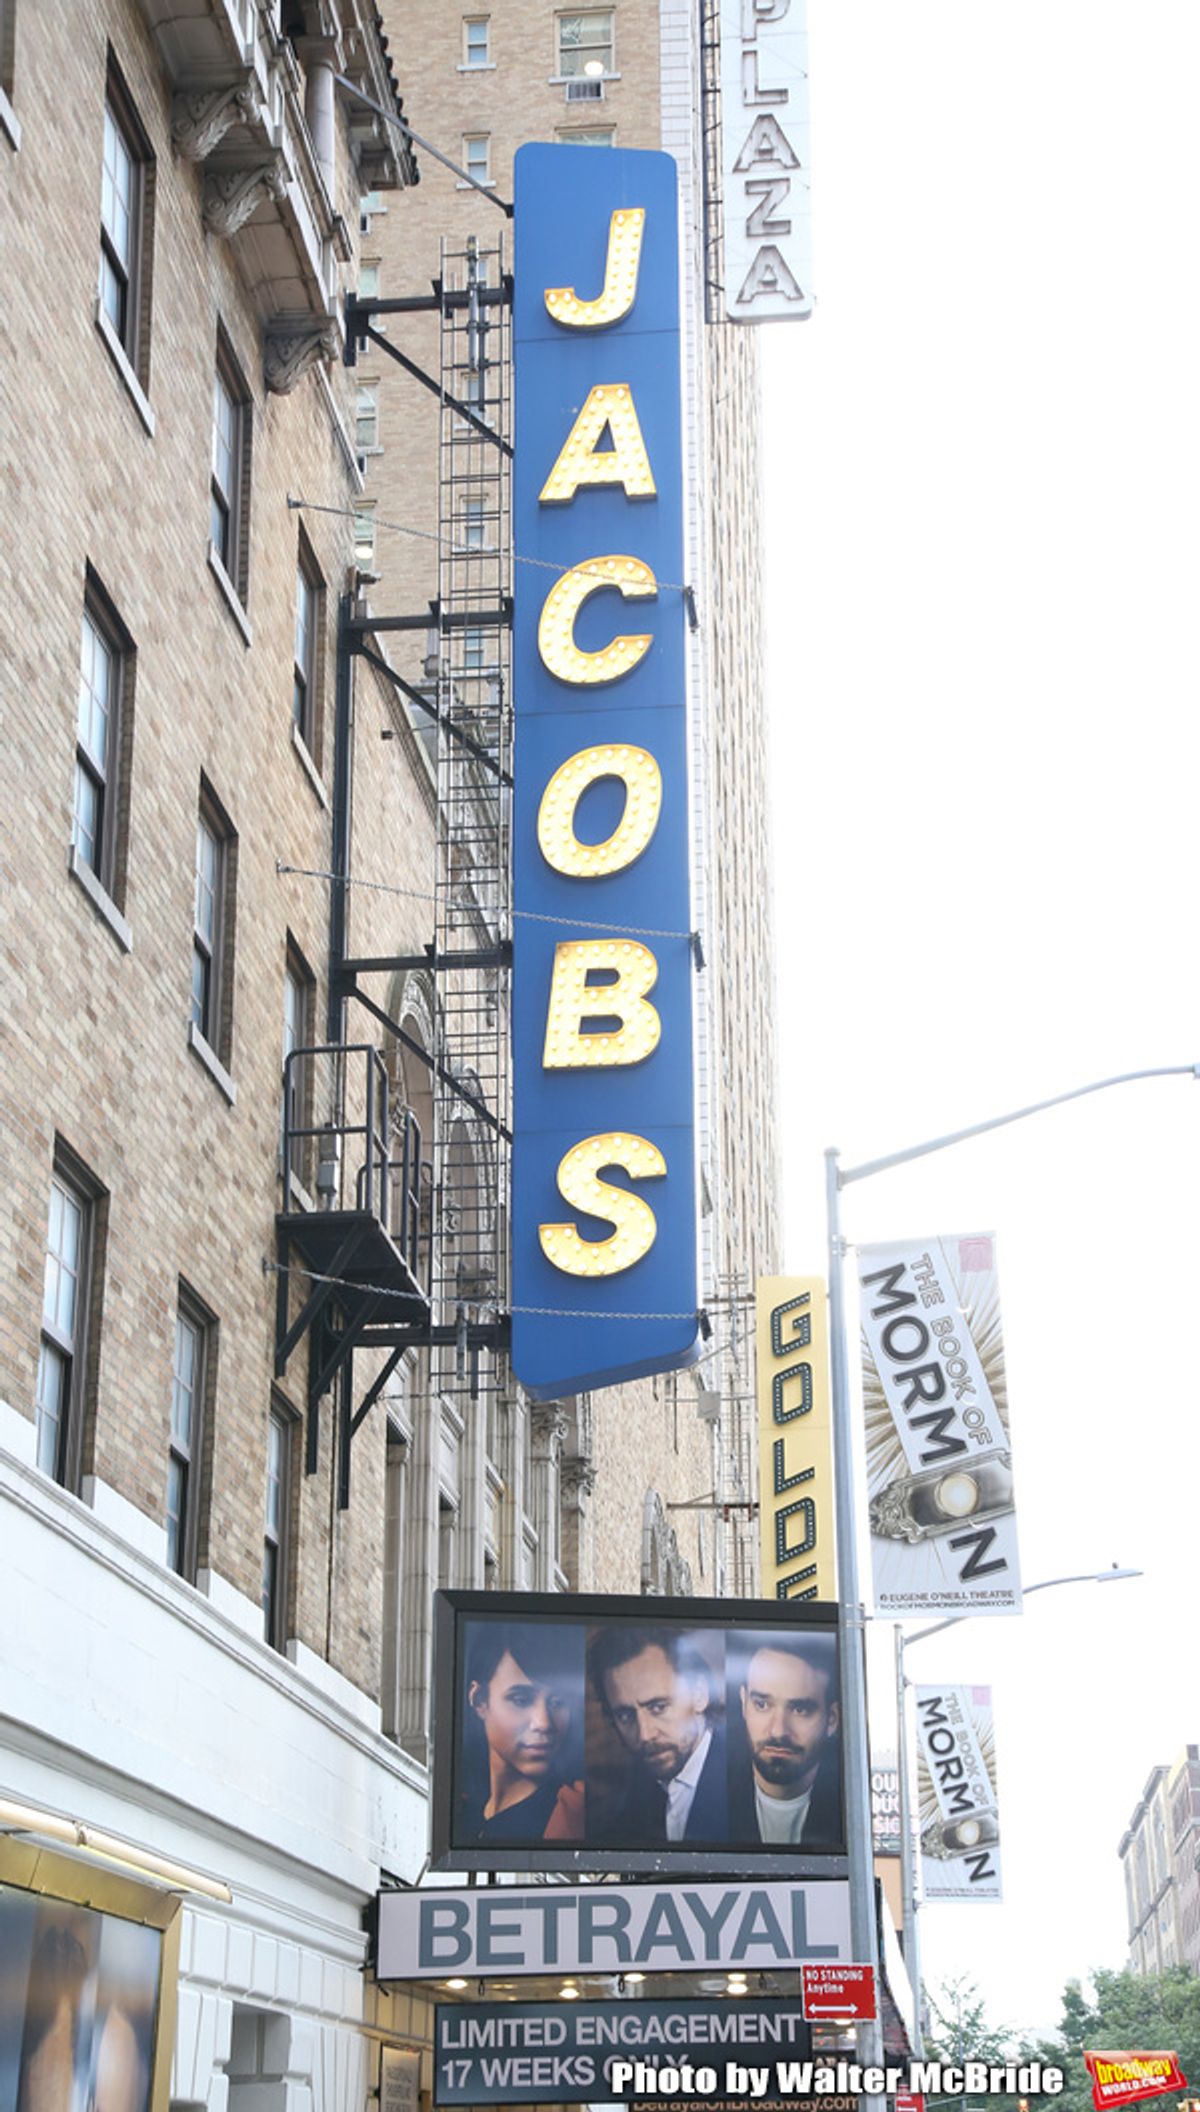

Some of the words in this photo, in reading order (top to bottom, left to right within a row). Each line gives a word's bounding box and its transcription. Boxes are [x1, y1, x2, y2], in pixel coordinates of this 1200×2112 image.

[732, 0, 804, 304] PLAZA
[537, 208, 667, 1278] JACOBS
[911, 1253, 945, 1309] THE
[930, 1316, 976, 1400] BOOK
[962, 1406, 993, 1446] OF
[945, 1692, 964, 1726] THE
[956, 1730, 981, 1778] BOOK
[972, 1782, 989, 1806] OF
[418, 1889, 839, 1968] BETRAYAL
[806, 1970, 819, 1981] NO
[820, 1970, 863, 1981] STANDING
[807, 1983, 844, 1995] Anytime
[442, 2017, 567, 2049] LIMITED
[576, 2014, 801, 2046] ENGAGEMENT
[442, 2059, 473, 2088] 17
[480, 2055, 595, 2087] WEEKS
